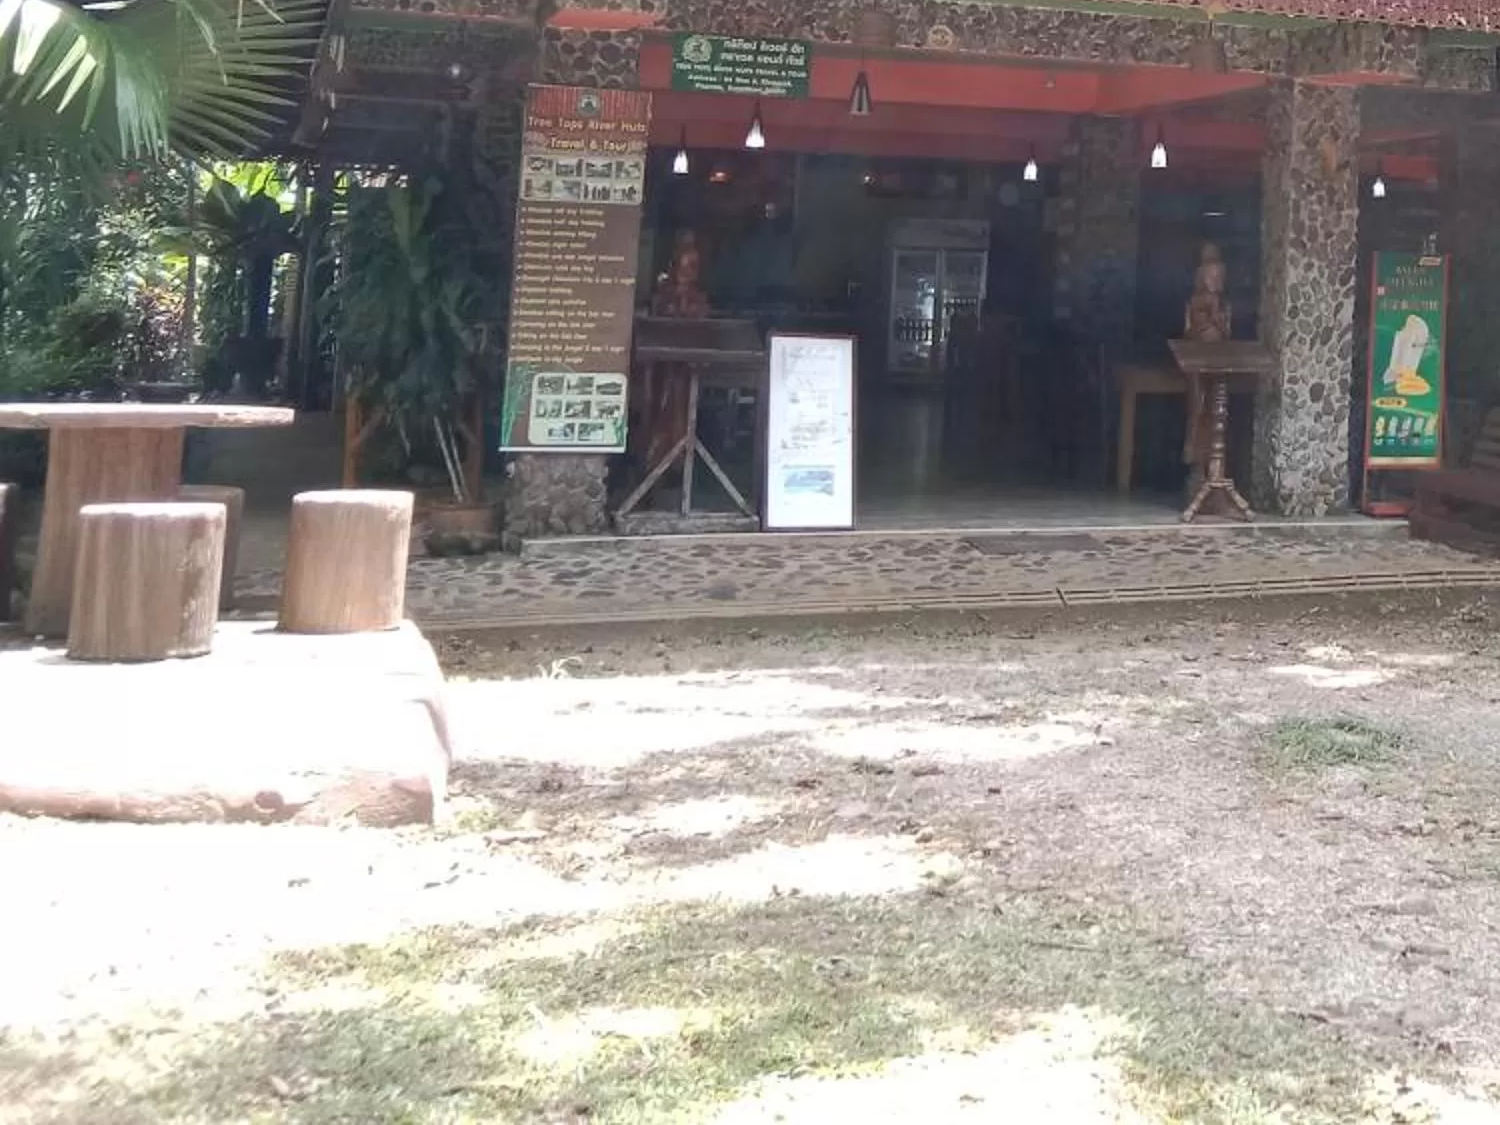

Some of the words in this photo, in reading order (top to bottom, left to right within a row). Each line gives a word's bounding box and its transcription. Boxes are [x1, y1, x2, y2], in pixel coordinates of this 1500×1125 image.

[528, 115, 553, 128] Tree
[558, 117, 584, 132] Tops
[589, 119, 616, 132] River
